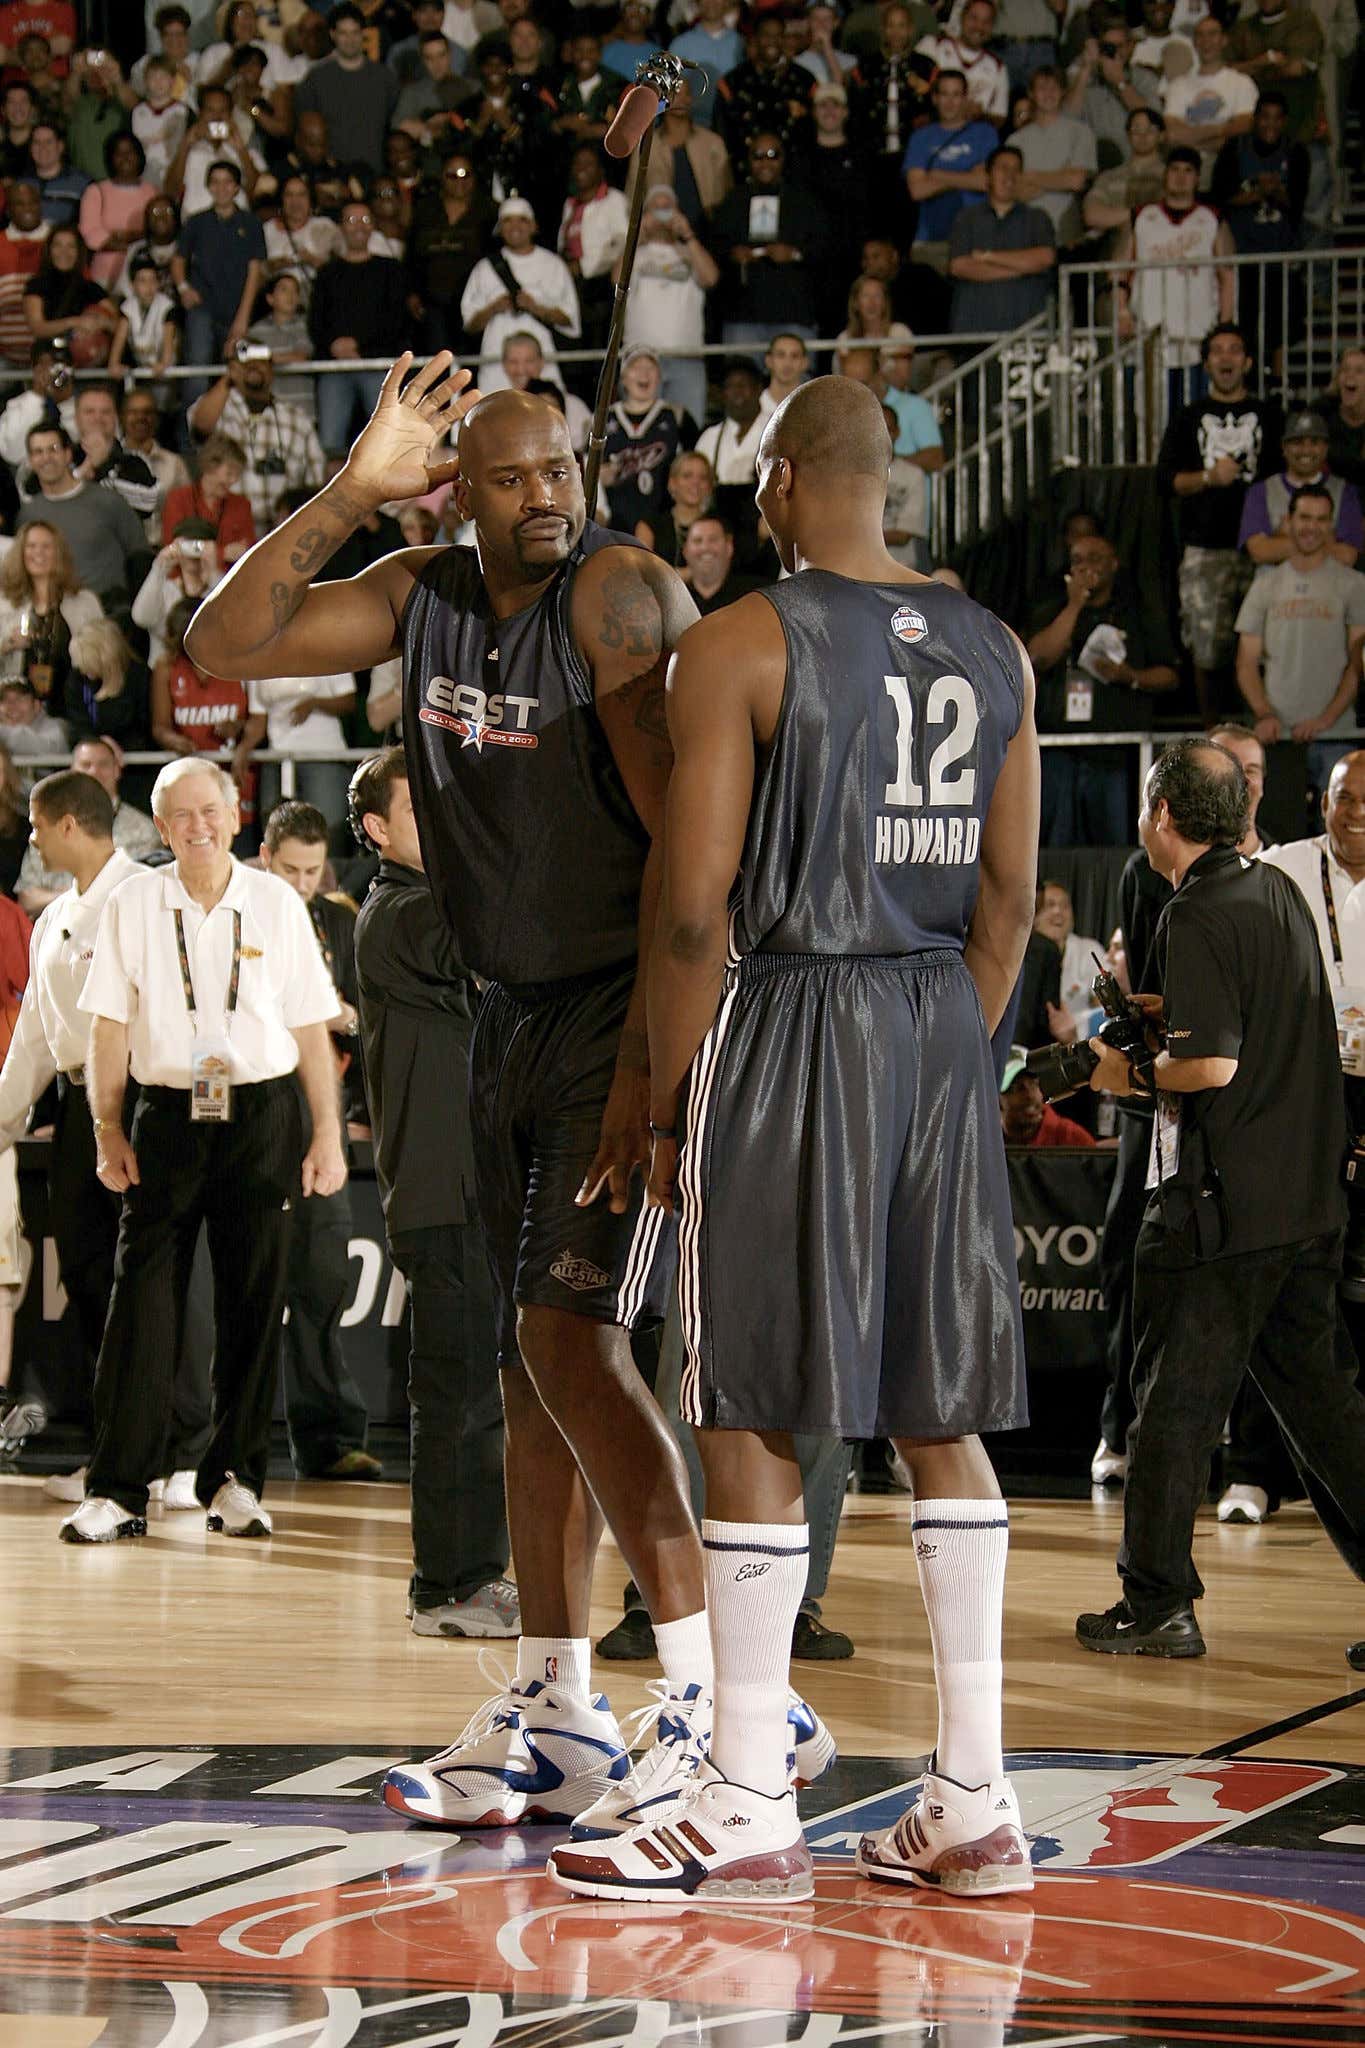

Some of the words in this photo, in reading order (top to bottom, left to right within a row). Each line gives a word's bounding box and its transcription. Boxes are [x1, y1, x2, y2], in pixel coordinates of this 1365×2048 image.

[427, 675, 540, 729] EAST
[174, 704, 238, 726] MIAMI
[508, 736, 533, 744] 2007
[884, 675, 980, 806] 12
[874, 815, 981, 865] HOWARD
[735, 1562, 771, 1582] East
[929, 1806, 944, 1820] 12
